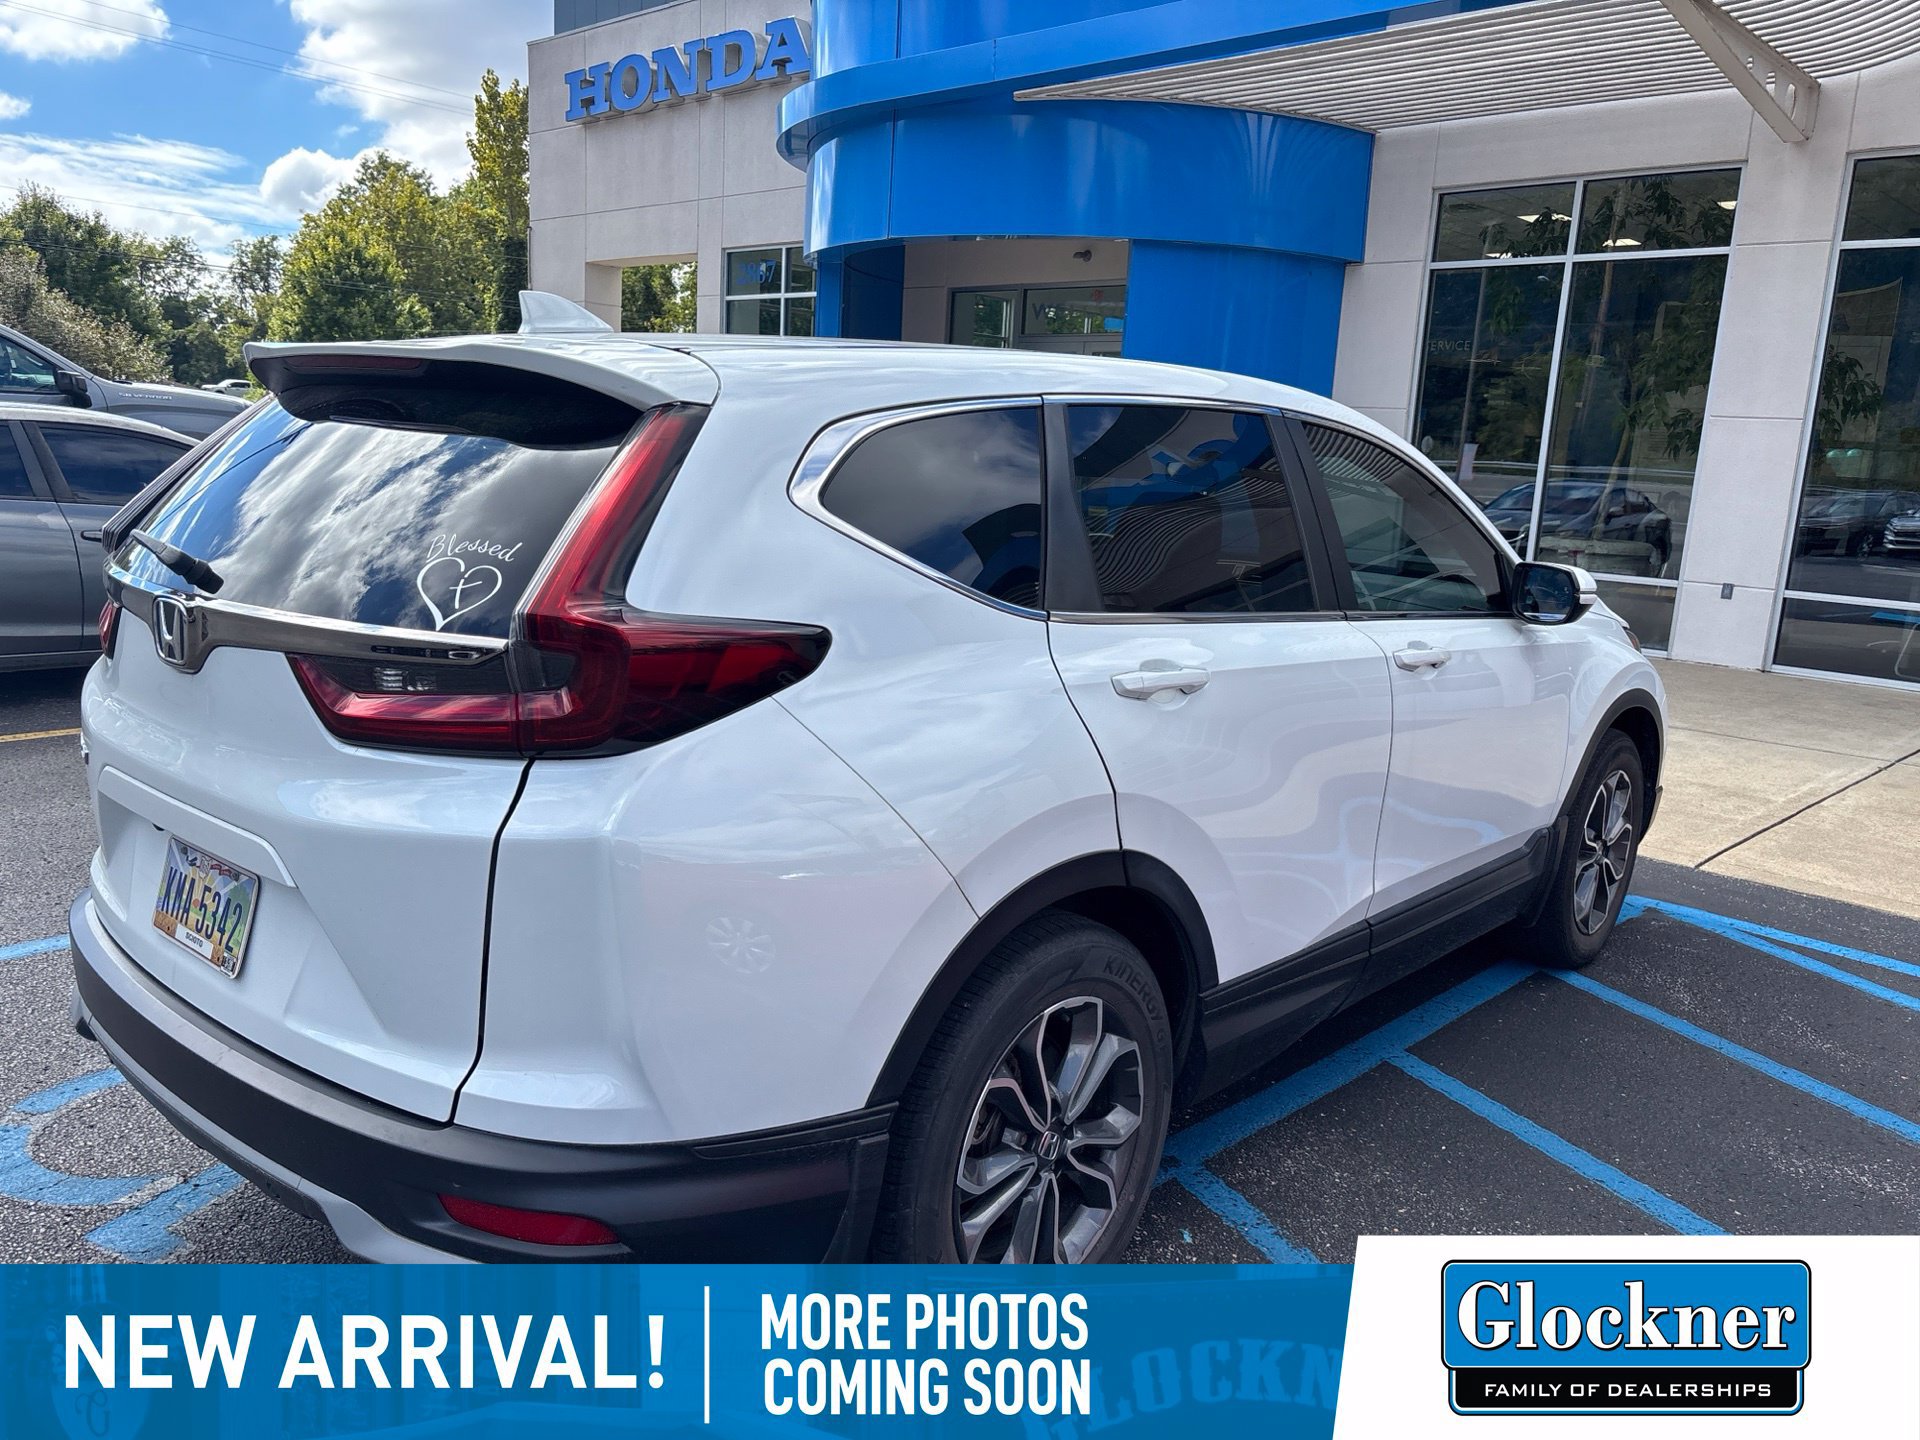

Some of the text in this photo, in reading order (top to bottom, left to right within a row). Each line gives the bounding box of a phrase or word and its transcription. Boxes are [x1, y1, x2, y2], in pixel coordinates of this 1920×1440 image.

[564, 17, 811, 122] HONDA
[426, 533, 523, 562] Blessed
[184, 930, 205, 949] SCIOTO
[195, 884, 243, 954] 5342
